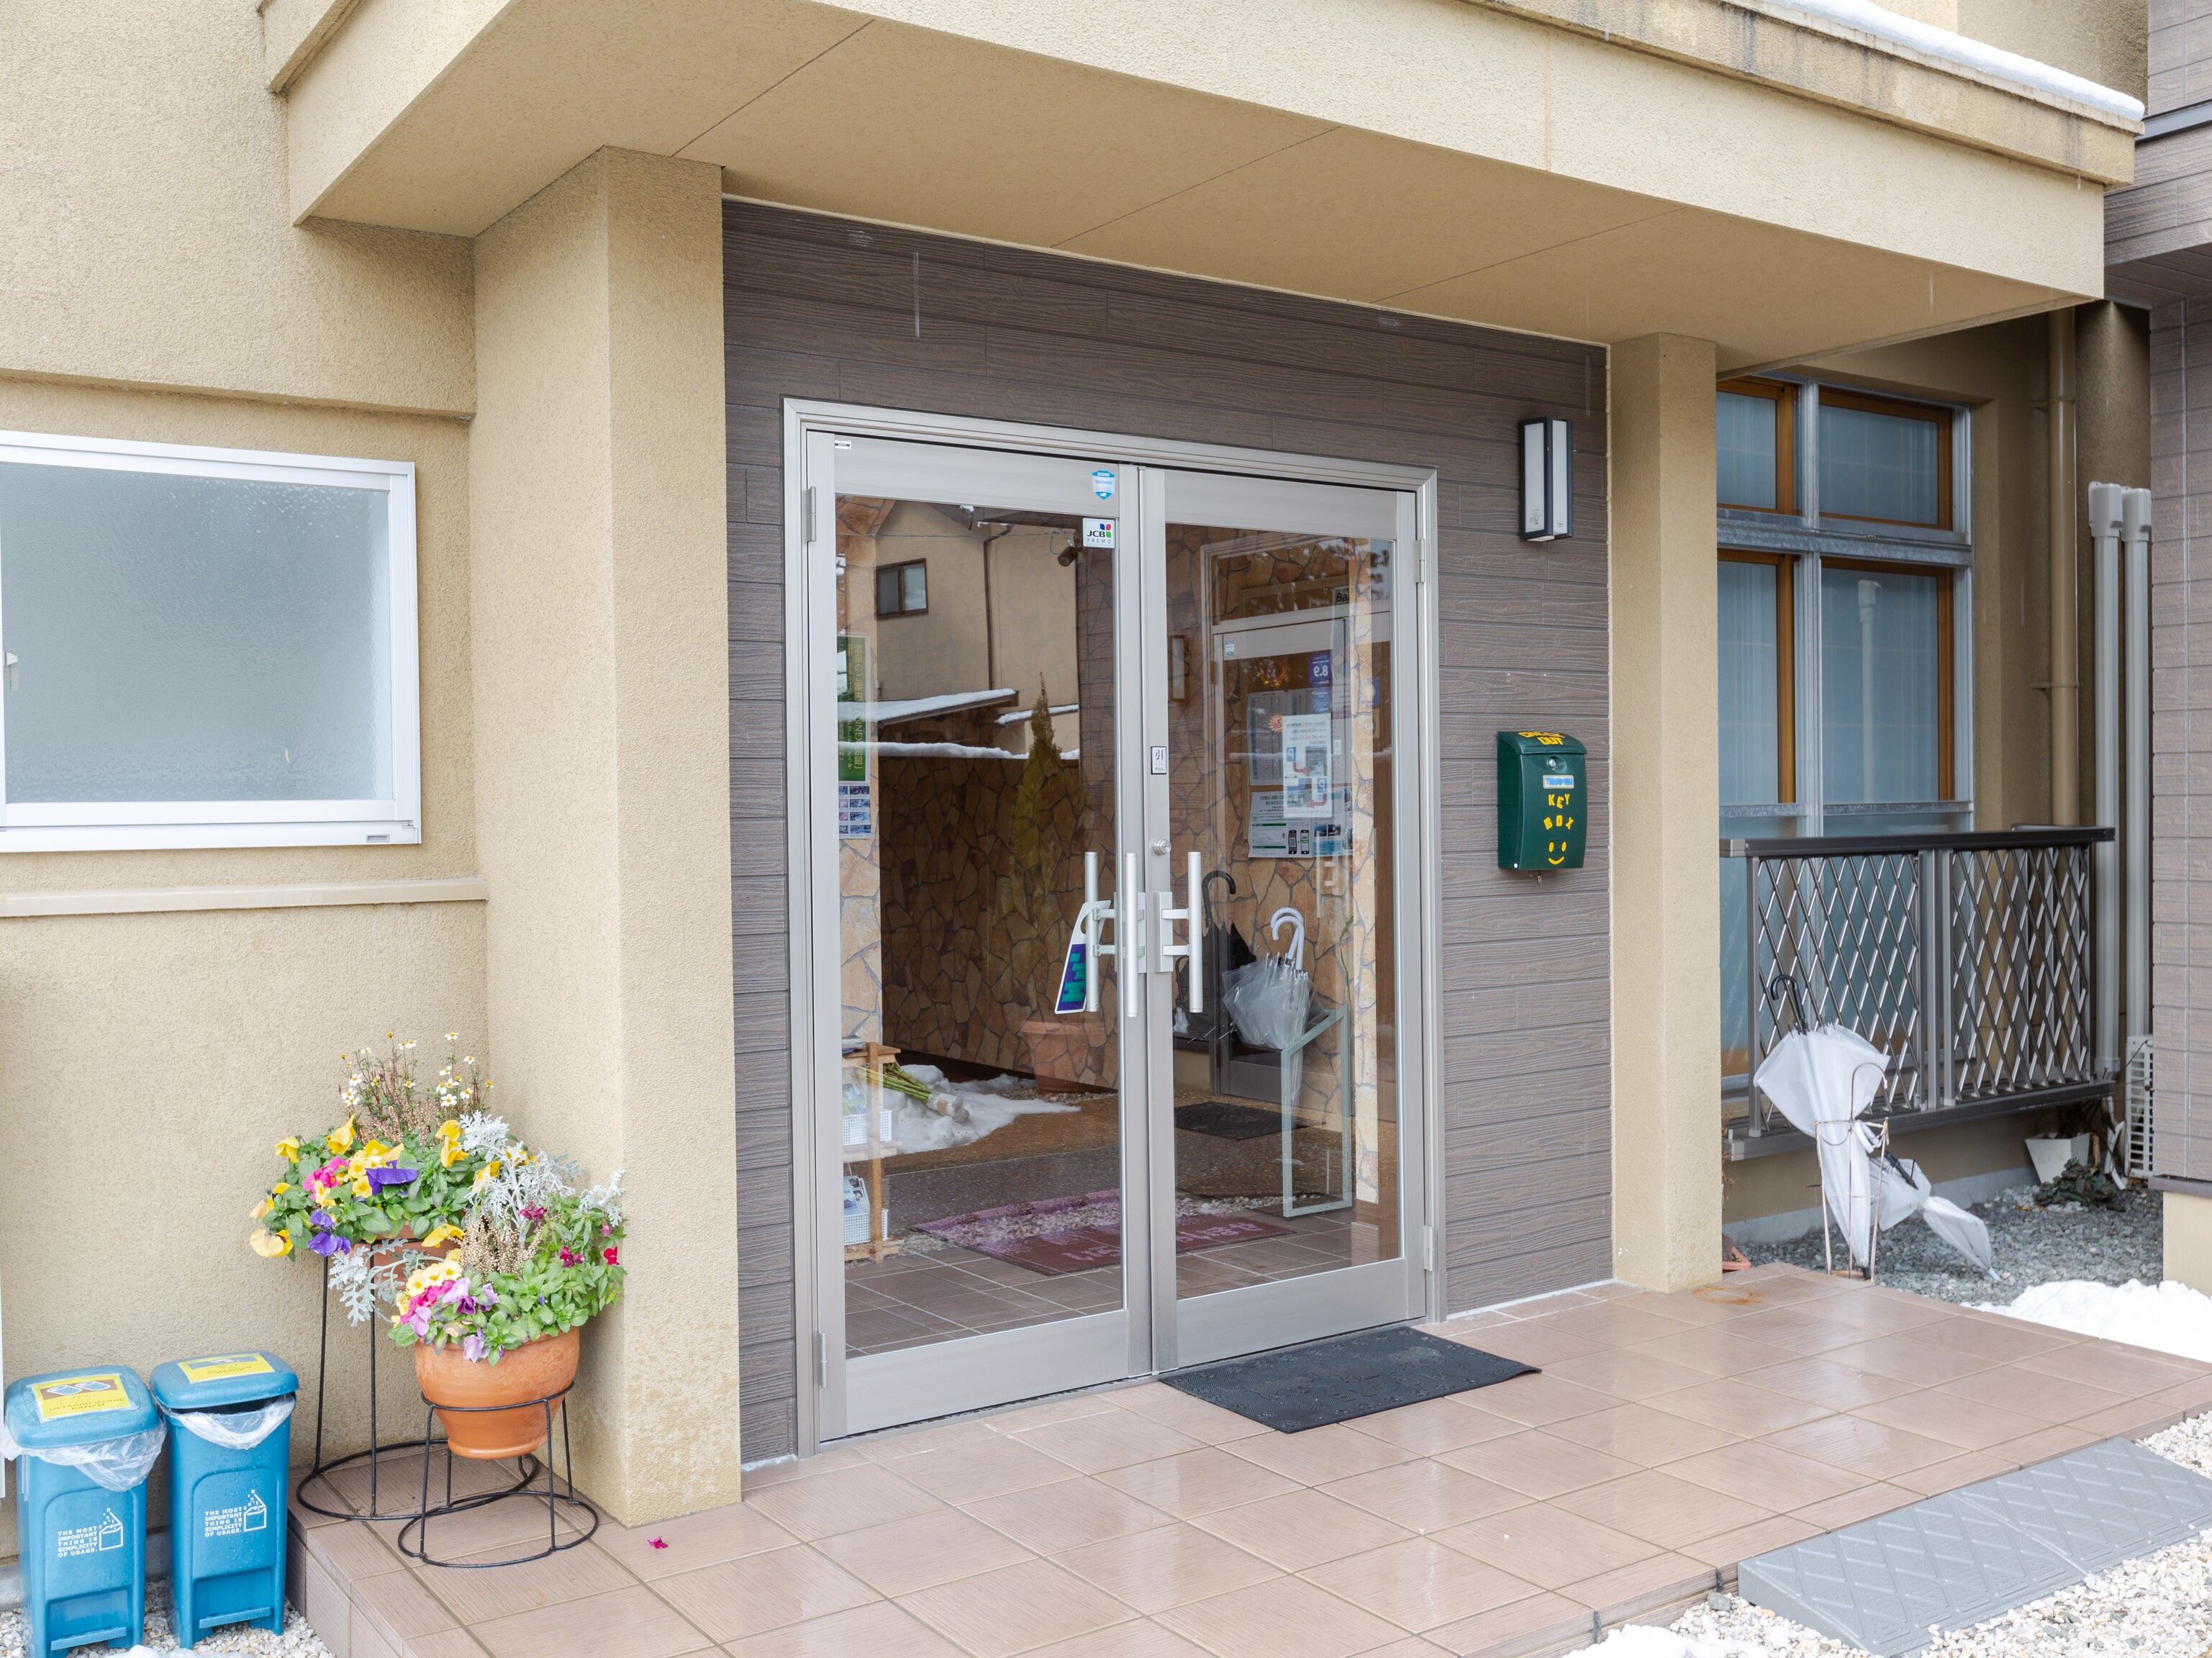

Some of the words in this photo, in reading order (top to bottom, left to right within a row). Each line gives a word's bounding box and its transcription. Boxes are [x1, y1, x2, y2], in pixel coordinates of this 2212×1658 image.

[1537, 736, 1564, 745] OUT
[1549, 794, 1570, 809] KEY
[1544, 815, 1574, 830] BOX
[204, 1512, 242, 1521] IMPORTANT
[204, 1523, 242, 1532] SIMPLICITY
[58, 1531, 98, 1541] IMPORTANT
[58, 1539, 85, 1547] THING
[58, 1541, 98, 1552] SIMPLICITY
[71, 1547, 98, 1556] USAGE.
